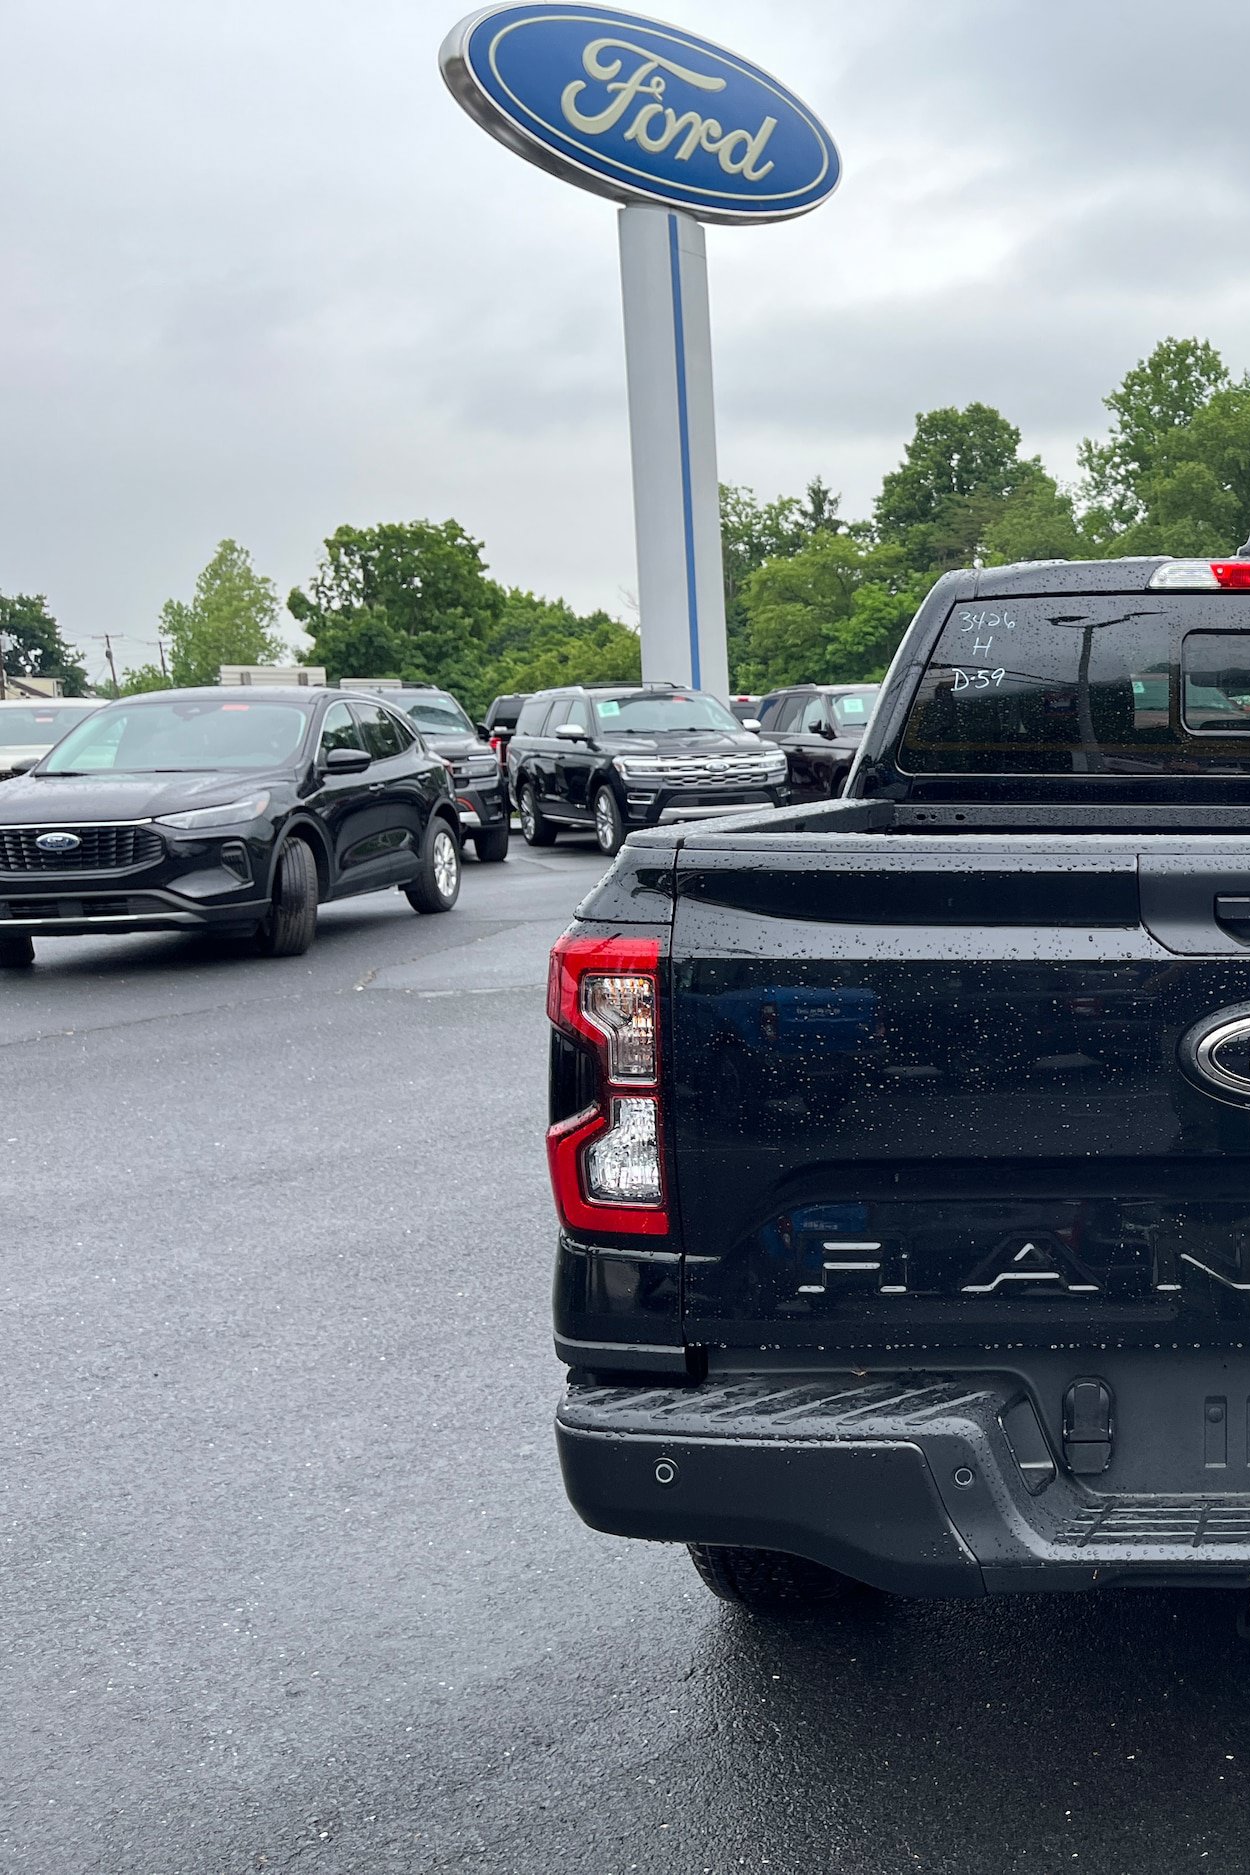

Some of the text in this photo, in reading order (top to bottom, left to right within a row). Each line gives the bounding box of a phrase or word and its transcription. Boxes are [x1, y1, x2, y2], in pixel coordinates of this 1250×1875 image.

[561, 38, 778, 182] Ford
[959, 611, 1016, 632] 3426
[972, 636, 993, 657] H
